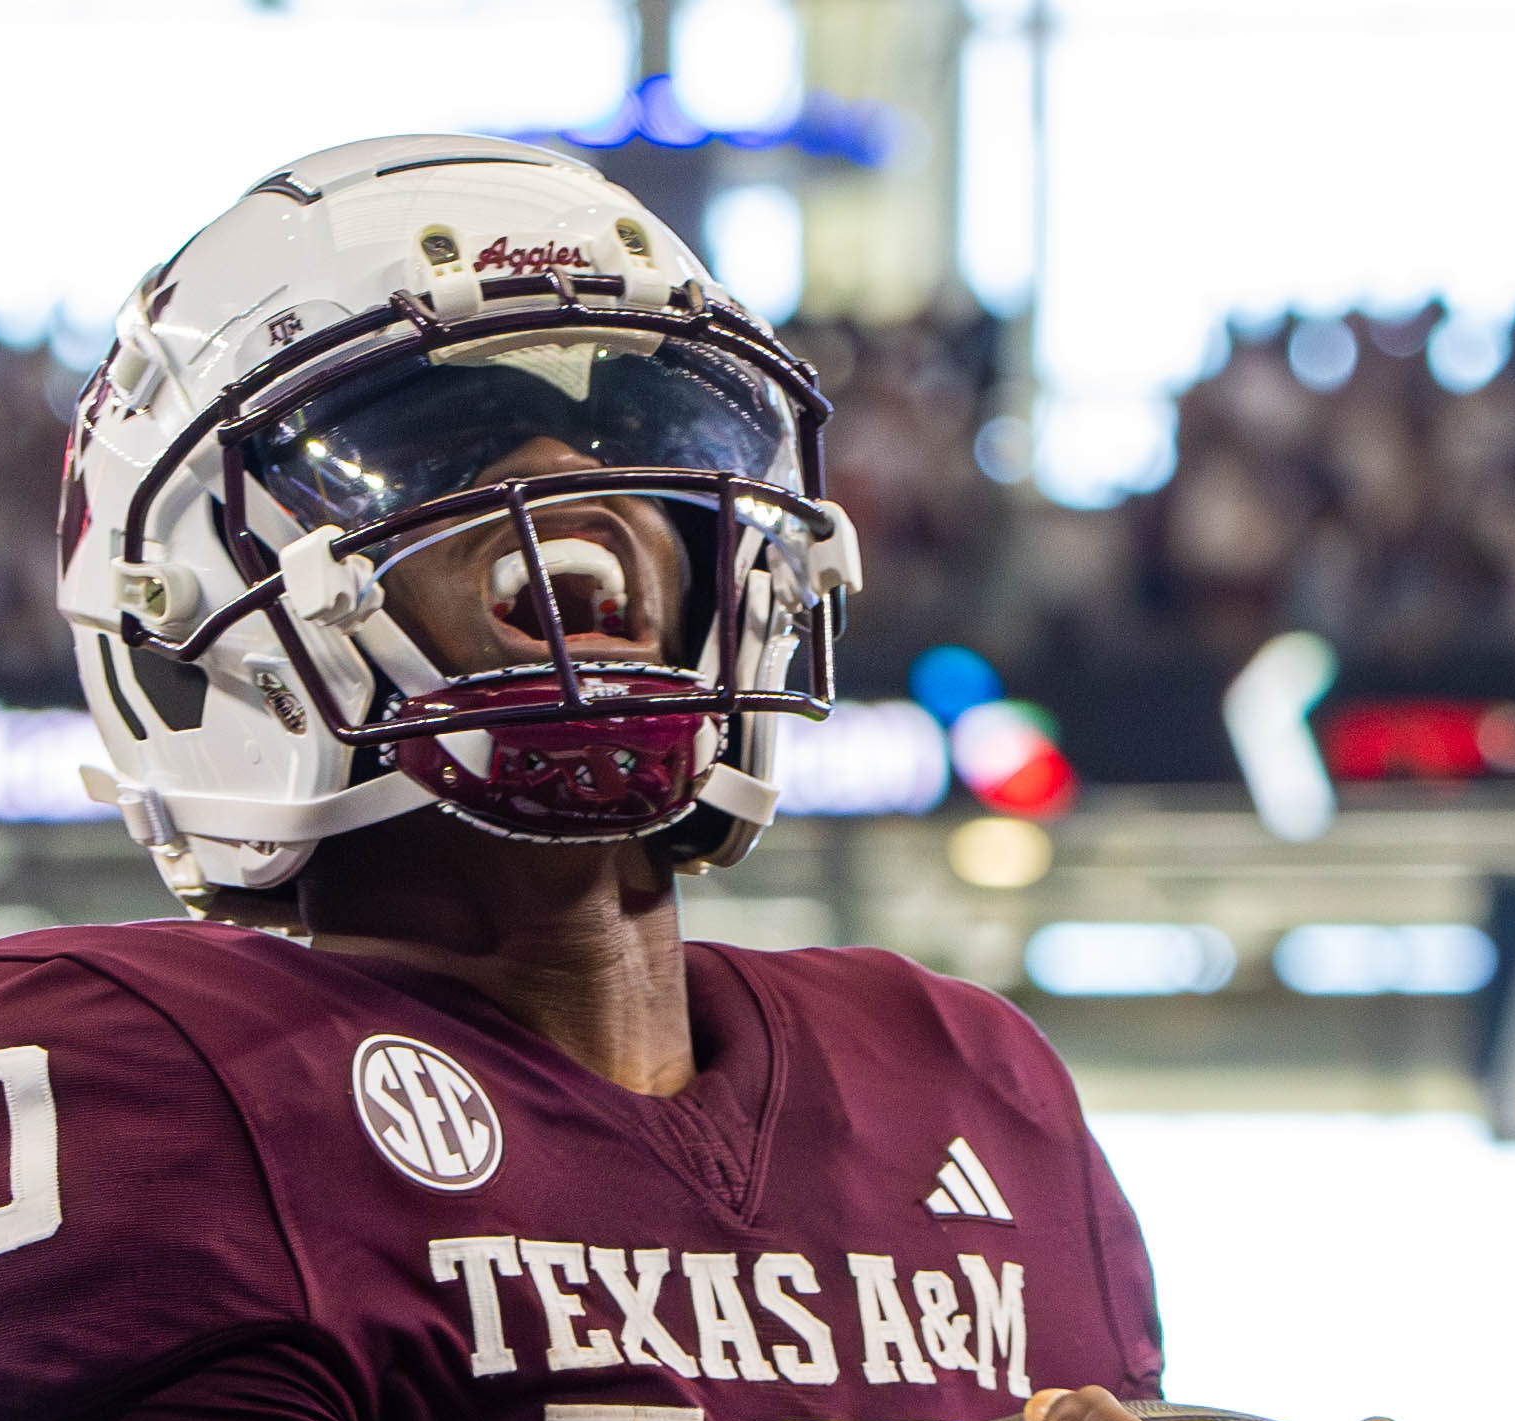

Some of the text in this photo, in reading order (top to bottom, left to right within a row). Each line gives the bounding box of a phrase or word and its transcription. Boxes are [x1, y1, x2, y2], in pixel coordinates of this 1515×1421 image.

[473, 236, 590, 275] Aggies
[362, 1046, 491, 1176] SEC
[429, 1235, 1031, 1398] TEXAS A&M
